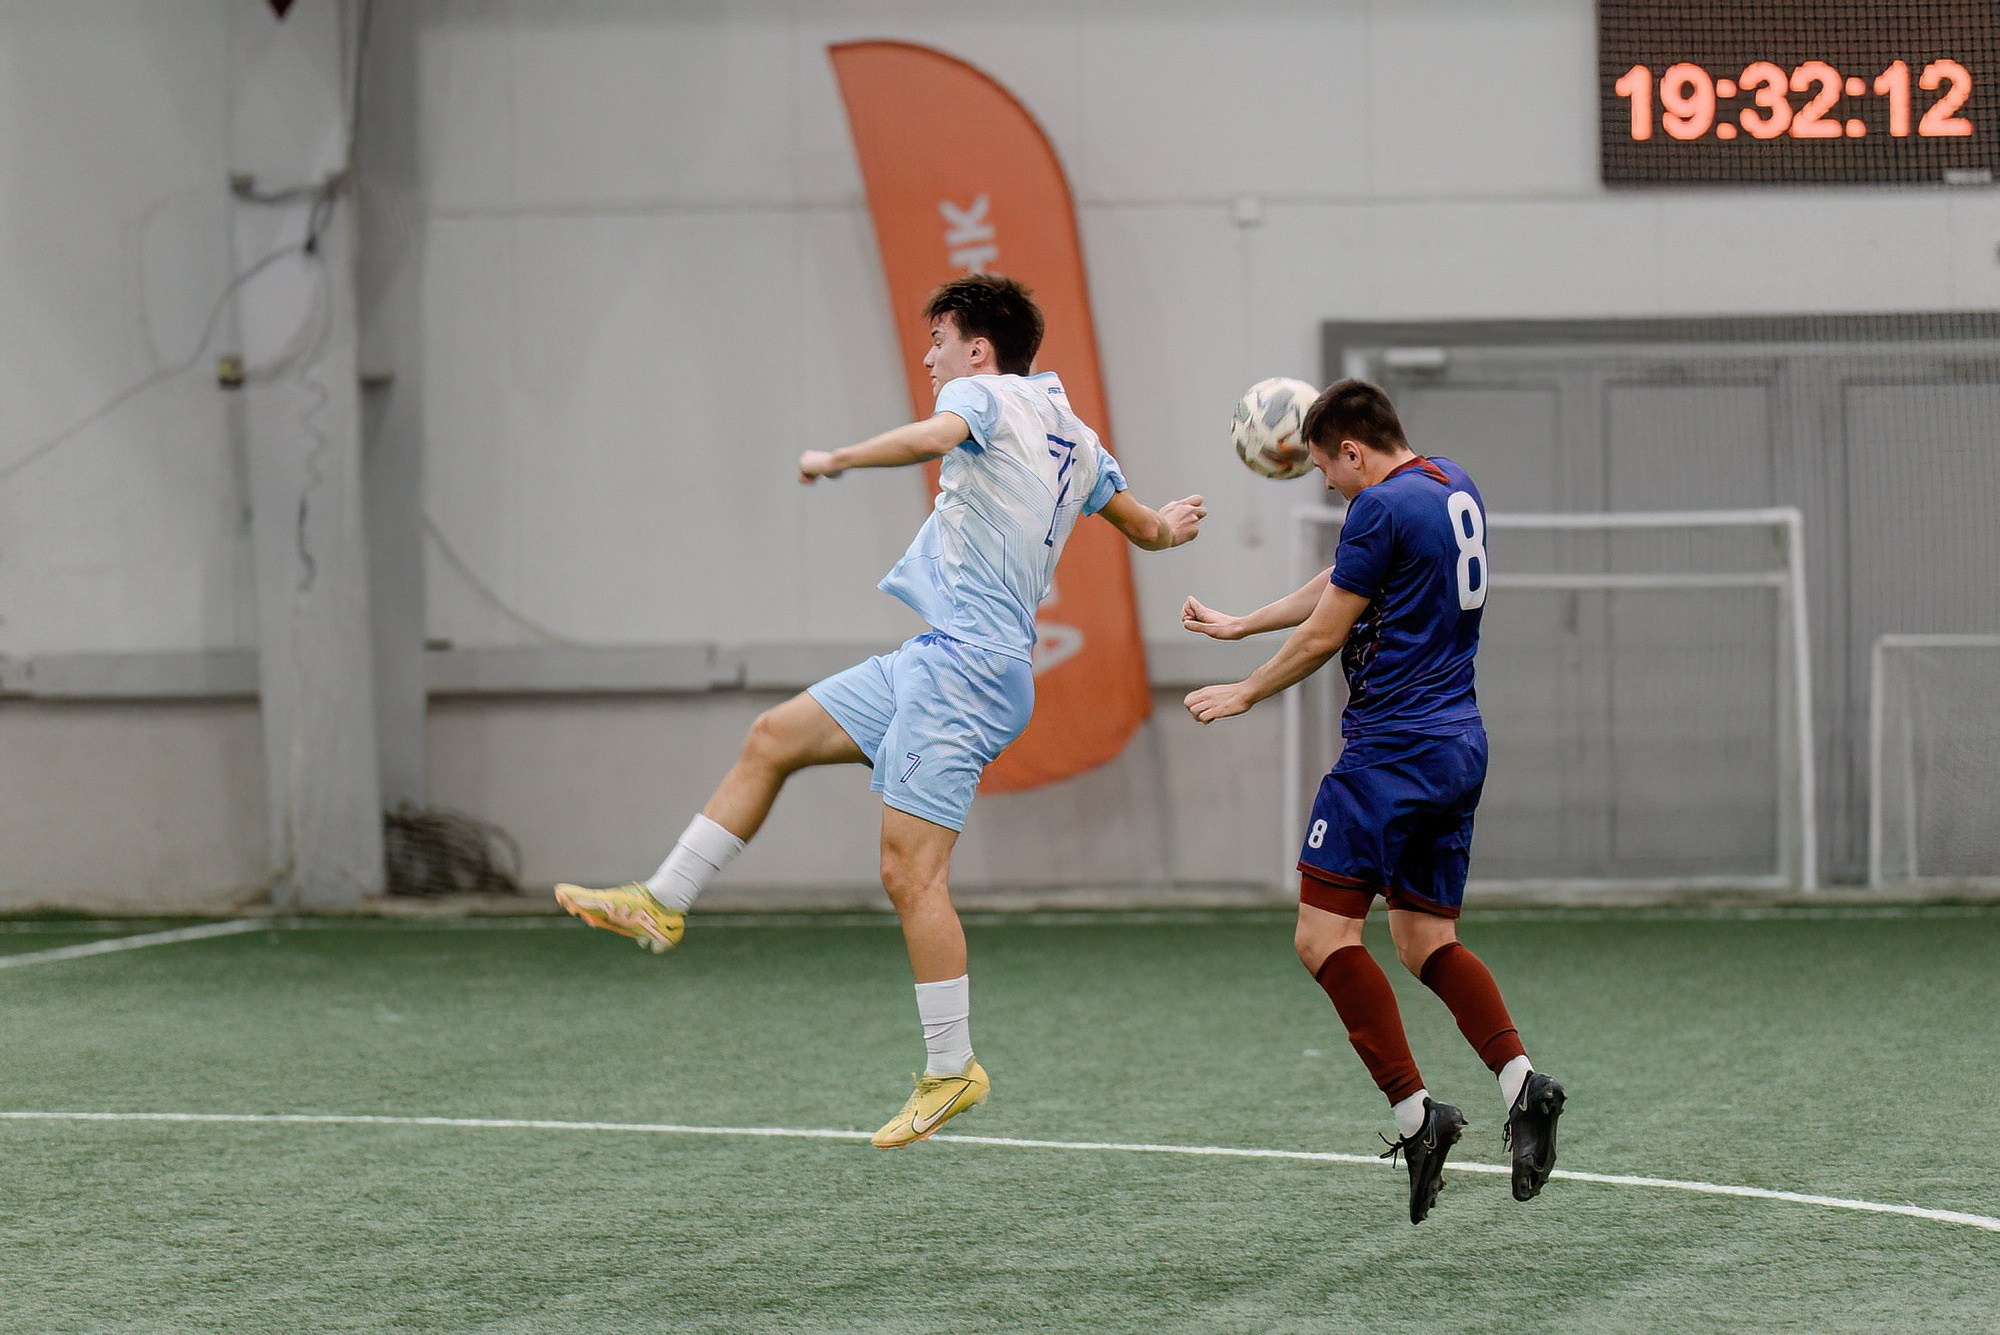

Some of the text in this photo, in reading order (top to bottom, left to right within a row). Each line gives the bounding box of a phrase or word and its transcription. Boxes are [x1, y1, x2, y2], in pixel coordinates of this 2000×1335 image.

[1615, 59, 1973, 141] 19:32:12
[1044, 433, 1077, 548] 7
[1447, 490, 1488, 611] 8
[900, 751, 922, 784] 7
[1308, 818, 1328, 849] 8
